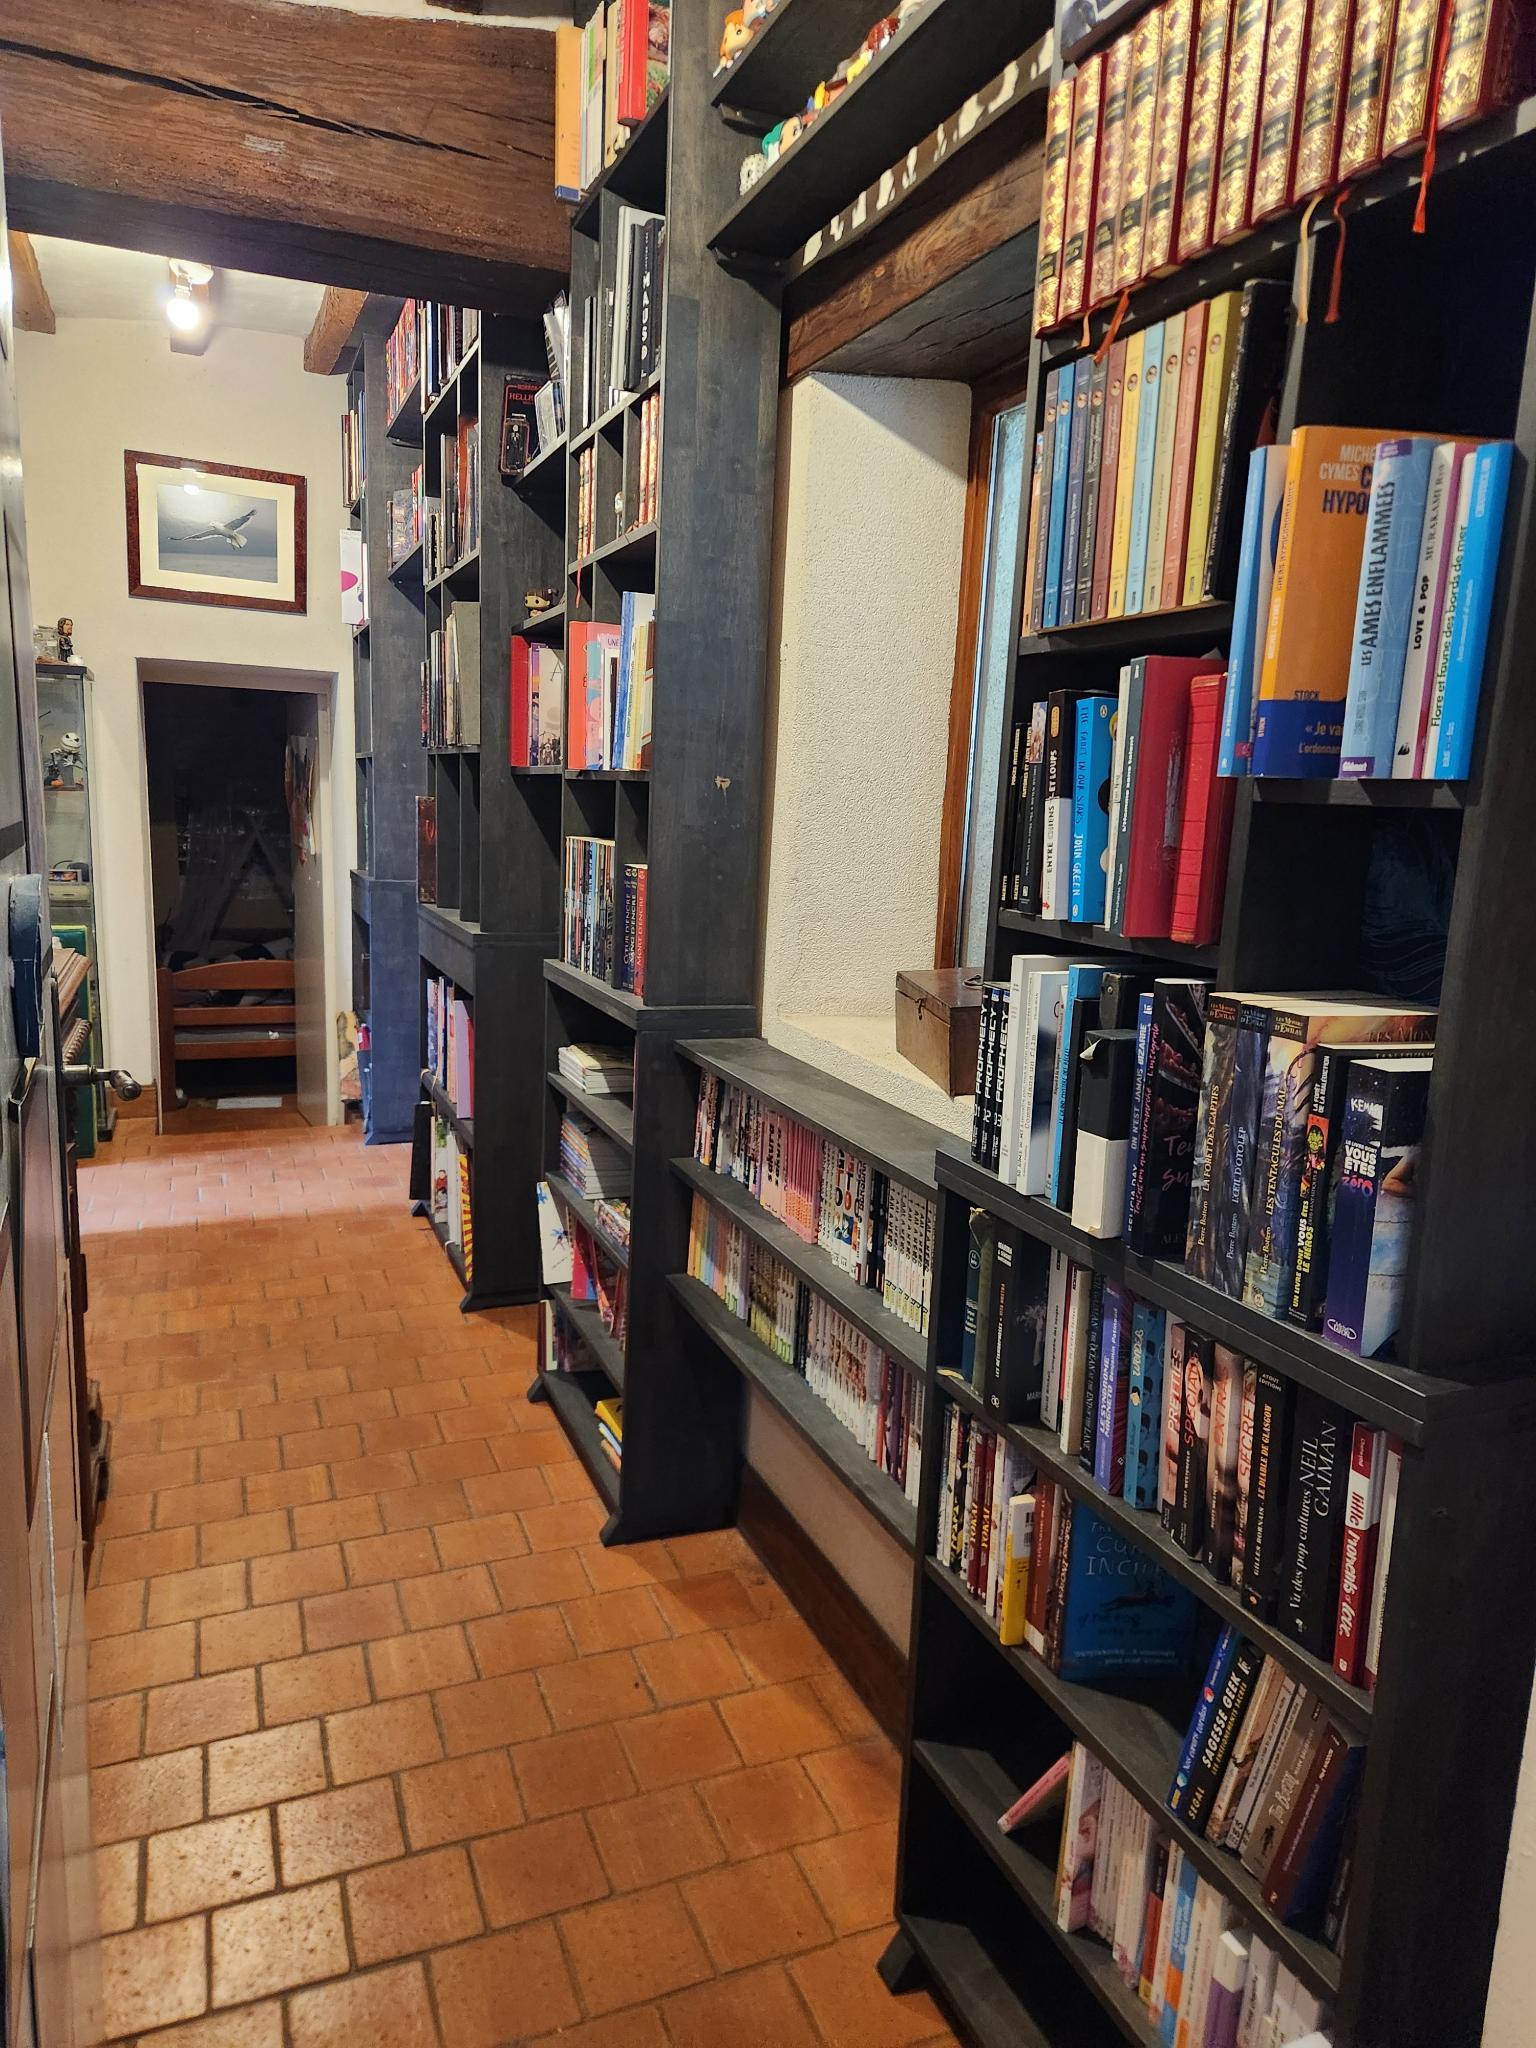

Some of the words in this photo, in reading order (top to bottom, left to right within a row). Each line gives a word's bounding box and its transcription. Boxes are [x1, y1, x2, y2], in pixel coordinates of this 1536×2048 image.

[641, 272, 651, 342] MAUS
[1320, 463, 1360, 480] CYMES
[1425, 490, 1439, 559] MURAKAMI
[1457, 526, 1465, 551] mer
[1452, 557, 1462, 571] de
[1419, 575, 1431, 599] POP
[1445, 575, 1459, 612] bords
[1418, 605, 1426, 614] &
[1412, 619, 1425, 649] LOVE
[1442, 616, 1454, 637] des
[1360, 650, 1370, 664] LES
[1436, 641, 1450, 677] faune
[1438, 681, 1444, 692] et
[1080, 707, 1088, 723] THE
[1430, 695, 1443, 726] Flore
[1078, 761, 1085, 770] IN
[1049, 781, 1056, 791] ET
[1072, 833, 1082, 858] JOHN
[1070, 863, 1080, 896] GREEN
[975, 1006, 986, 1092] PROPHECY
[984, 1009, 995, 1097] PROPHECY
[996, 1012, 1008, 1101] PROPHECY
[1136, 1023, 1147, 1065] BIZARRE
[1135, 1068, 1143, 1101] JAMAIS
[1314, 1055, 1329, 1094] MALÉDICTION
[1209, 1085, 1218, 1124] CAPTIFS
[1276, 1087, 1285, 1110] MAL
[1312, 1103, 1318, 1111] LA
[1316, 1103, 1325, 1114] DE
[1319, 1095, 1324, 1104] LA
[1274, 1111, 1283, 1128] DU
[1131, 1136, 1137, 1149] ON
[1205, 1126, 1214, 1144] DES
[1234, 1127, 1245, 1174] D'OTOLEP
[1268, 1130, 1284, 1193] TENTACULES
[1345, 1145, 1377, 1165] VOUS
[1201, 1179, 1209, 1190] LA
[1199, 1201, 1207, 1225] Bottero
[1265, 1196, 1273, 1214] LES
[1197, 1227, 1205, 1245] Pierre
[1228, 1213, 1236, 1237] Bottero
[1296, 1216, 1307, 1247] VOUS
[1226, 1240, 1234, 1258] Pierre
[1262, 1226, 1270, 1252] Bottero
[1302, 1224, 1315, 1257] HÉROS
[1259, 1254, 1268, 1273] Pierre
[1295, 1247, 1304, 1271] DONT
[1301, 1258, 1310, 1273] LE
[1291, 1293, 1299, 1307] UN
[1088, 1343, 1097, 1369] OCEAN
[1100, 1358, 1113, 1415] SYNDROME
[1170, 1347, 1183, 1430] PRETTIES
[1182, 1350, 1200, 1447] SPECIALS
[1216, 1364, 1229, 1436] EXTRAS
[1098, 1422, 1103, 1432] LE
[1237, 1382, 1257, 1477] SECRETS
[1262, 1405, 1271, 1442] GLASGOW
[1260, 1442, 1269, 1456] DE
[1258, 1458, 1267, 1486] DIABLE
[1300, 1439, 1317, 1485] NEIL
[1315, 1427, 1334, 1515] GAIMAN
[1257, 1488, 1264, 1499] LE
[1298, 1491, 1310, 1539] cultures
[1350, 1492, 1363, 1525] little
[1296, 1542, 1307, 1569] pop
[1343, 1531, 1358, 1592] moments
[1291, 1571, 1302, 1591] des
[1289, 1593, 1300, 1608] Vu
[1203, 1710, 1226, 1766] SAGESSE
[1223, 1673, 1239, 1707] GEEK
[1188, 1787, 1203, 1818] SEGAL
